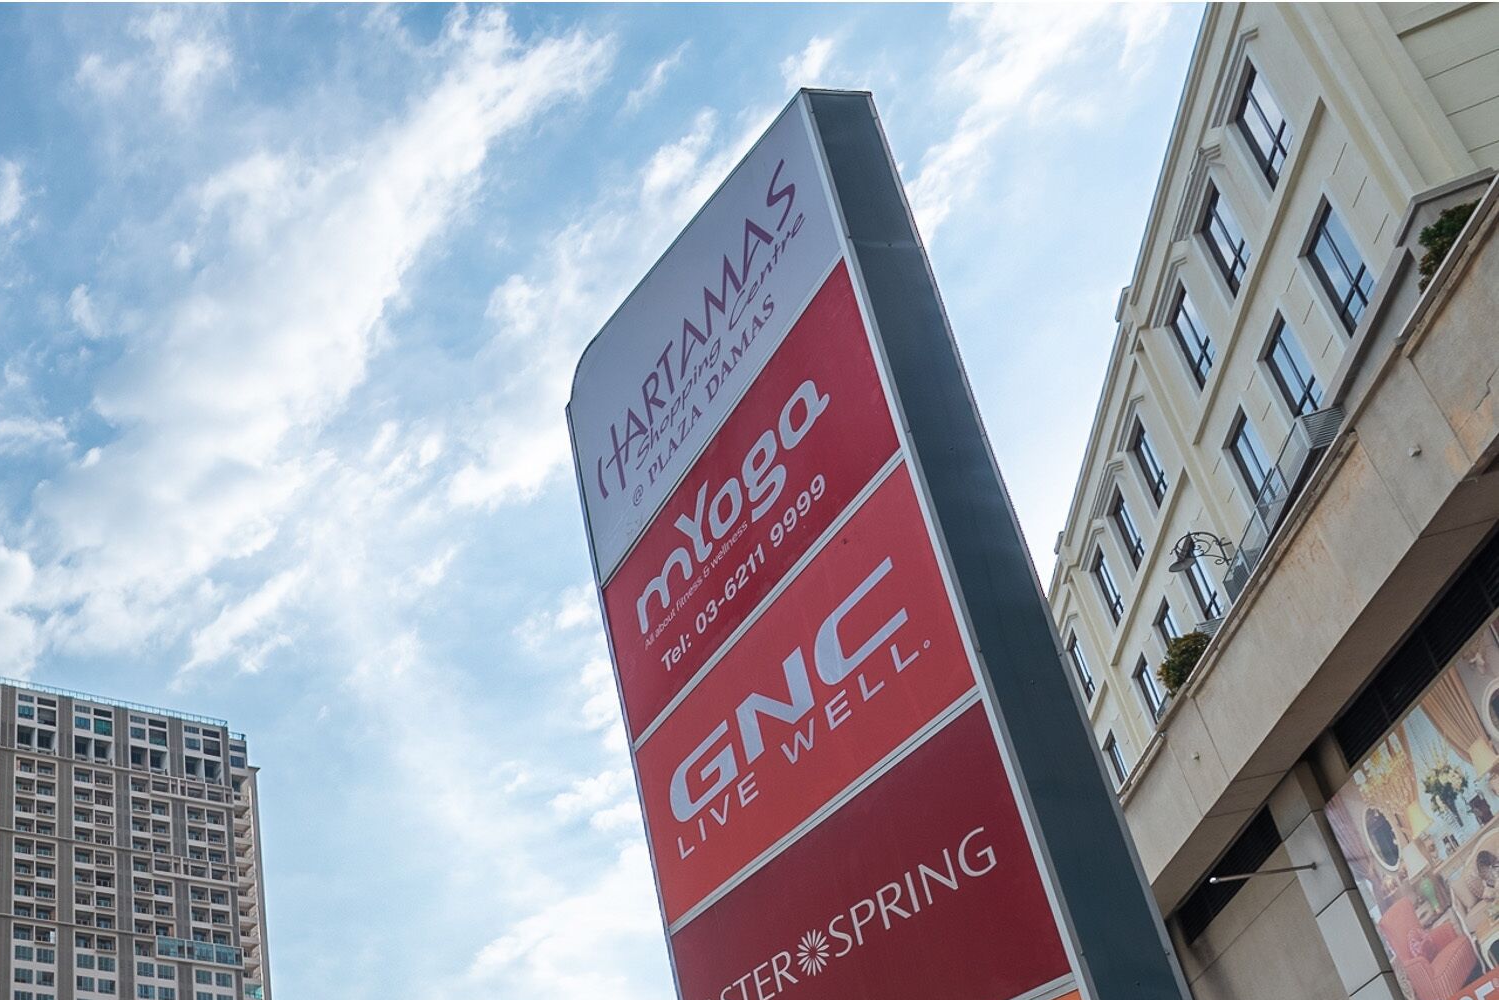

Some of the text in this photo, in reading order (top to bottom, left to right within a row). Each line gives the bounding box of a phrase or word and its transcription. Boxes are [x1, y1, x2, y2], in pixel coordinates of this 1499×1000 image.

[597, 158, 797, 501] HARTAMAS
[636, 212, 806, 470] Shopping Centre
[648, 407, 703, 488] PLAZA
[704, 293, 776, 404] DAMAS
[635, 378, 831, 635] mYoga
[654, 610, 677, 638] about
[676, 579, 703, 613] fitness
[709, 520, 749, 569] wellness
[660, 473, 827, 673] Tel: 03-6211 9999
[669, 555, 909, 824] GNC
[674, 772, 761, 860] LIVE
